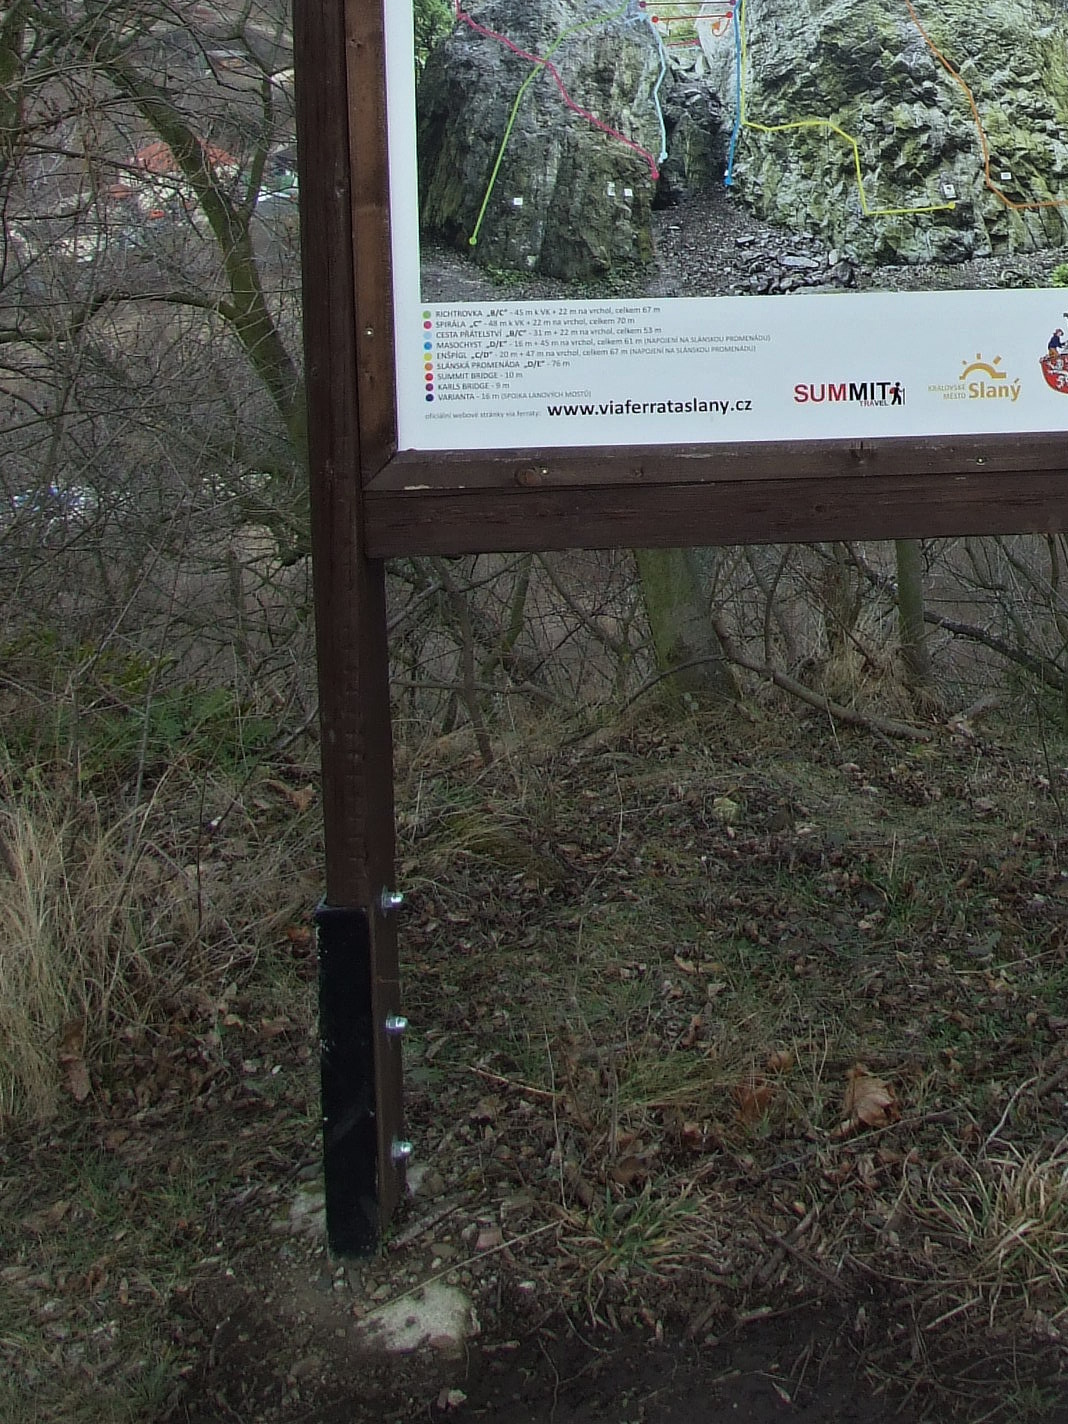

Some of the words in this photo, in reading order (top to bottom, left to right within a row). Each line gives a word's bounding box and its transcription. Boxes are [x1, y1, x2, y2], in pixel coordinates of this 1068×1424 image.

[793, 382, 891, 403] SUMMIT
[968, 378, 1021, 402] Slaný
[547, 398, 752, 416] www.viaferrataslany.cz
[859, 399, 889, 407] TRAVEL
